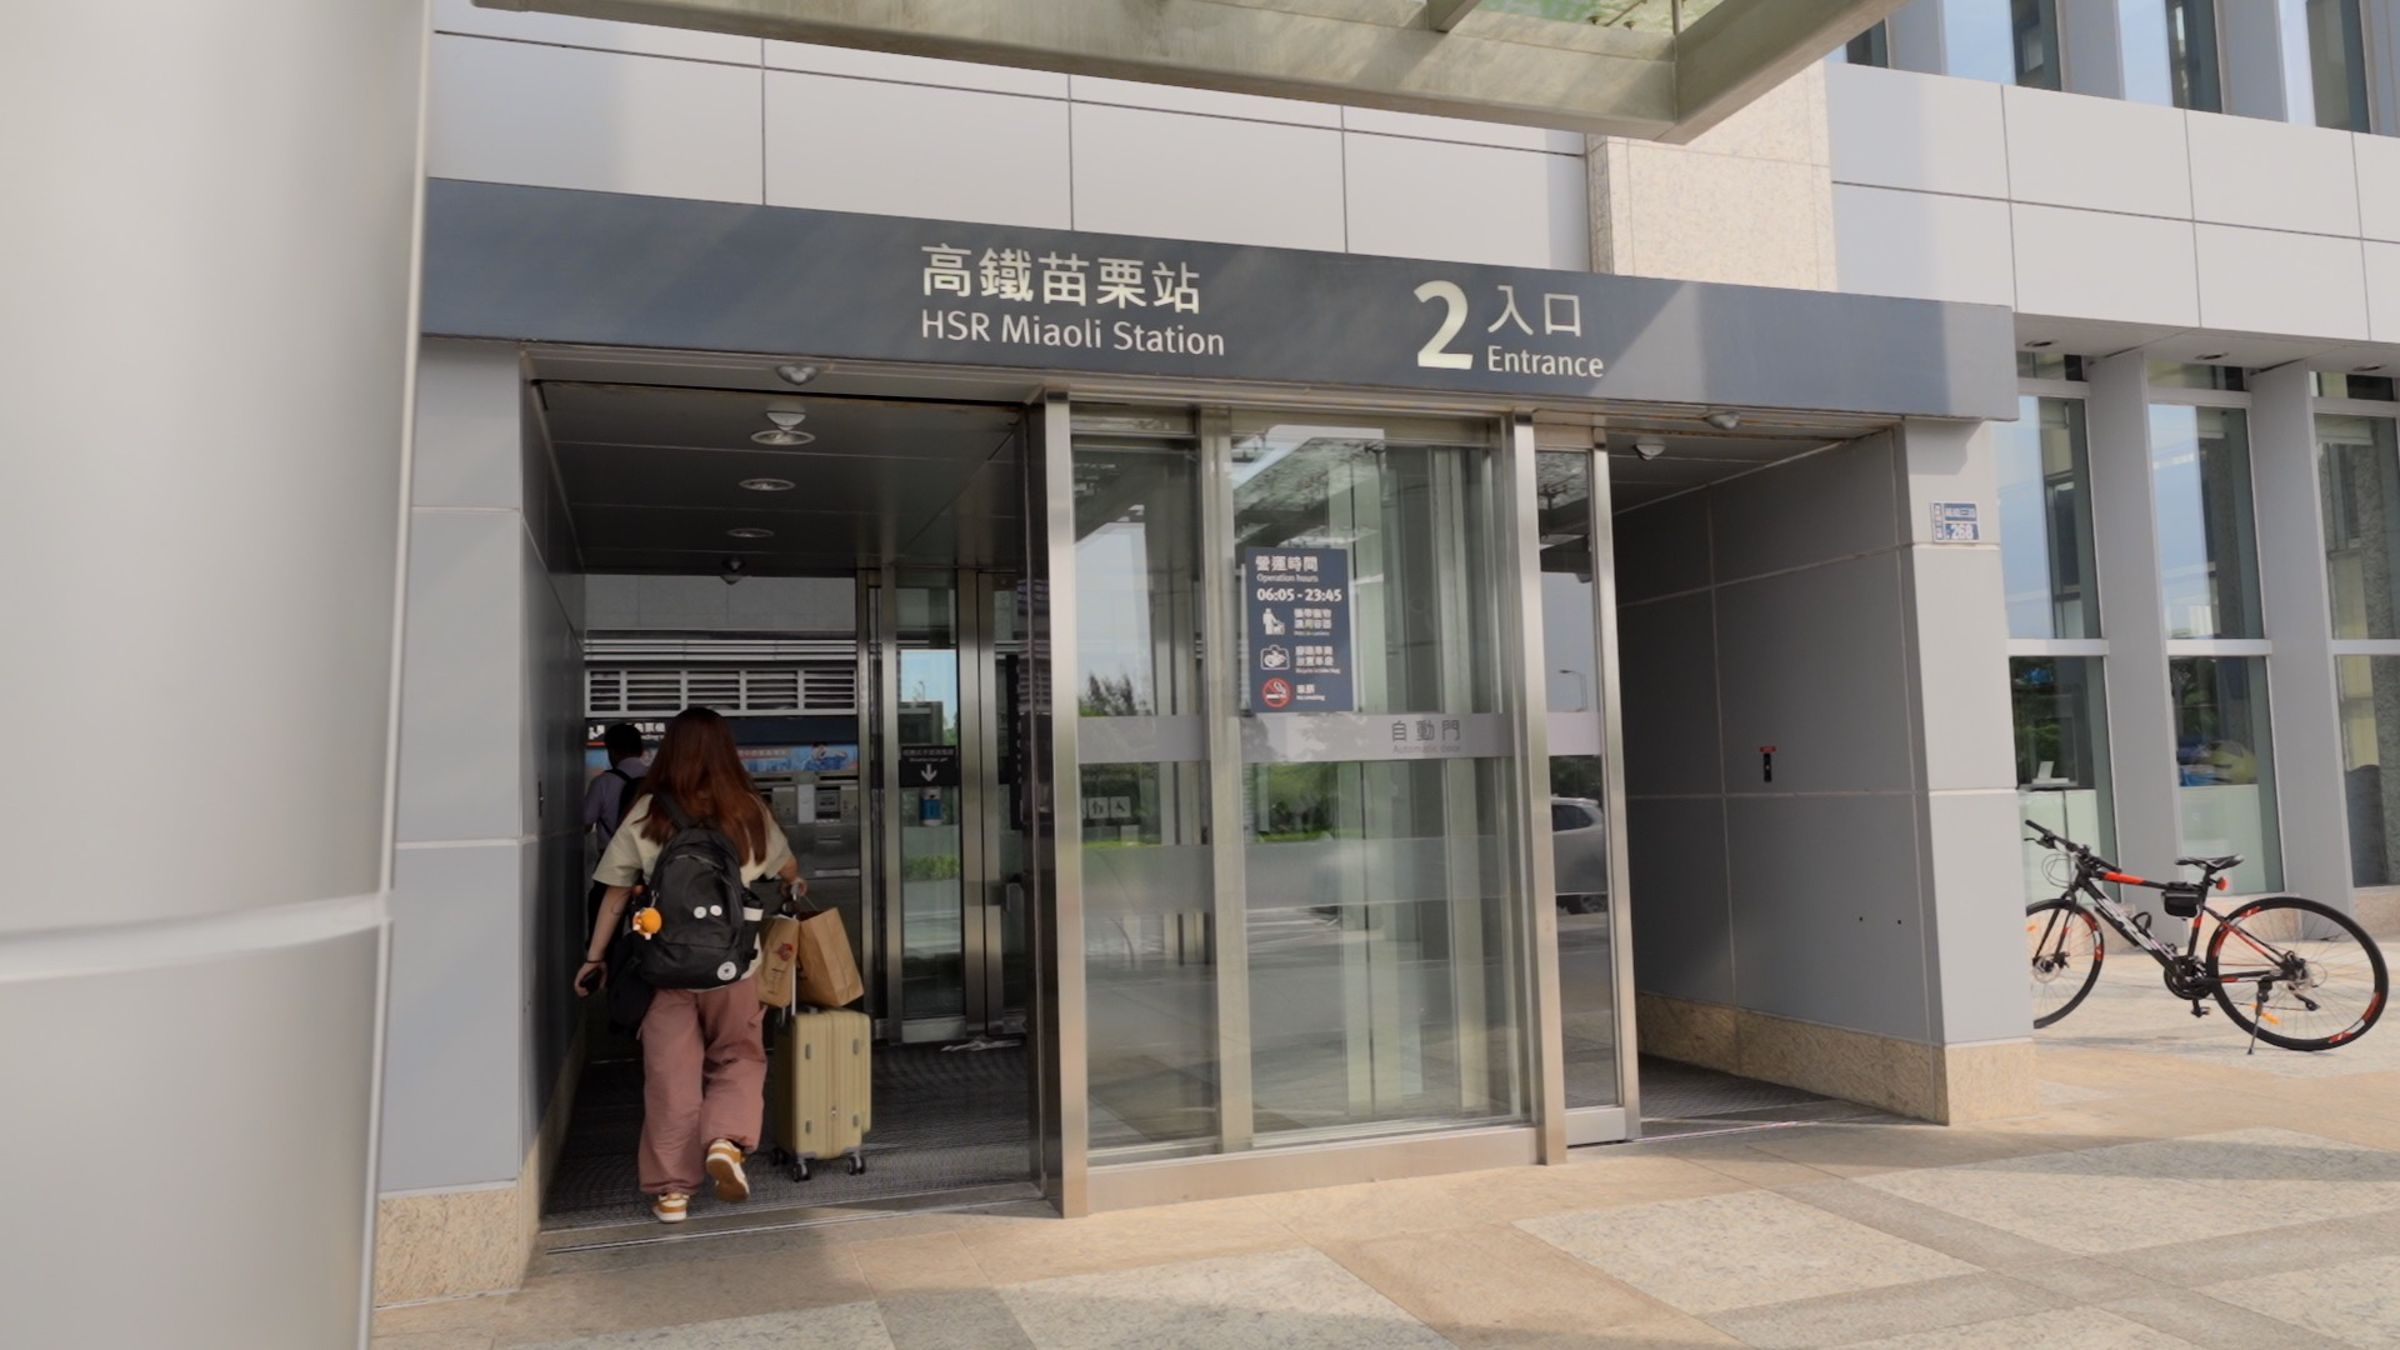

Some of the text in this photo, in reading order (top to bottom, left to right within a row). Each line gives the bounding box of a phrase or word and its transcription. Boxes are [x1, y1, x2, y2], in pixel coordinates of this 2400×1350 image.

[921, 243, 1200, 314] 高鐵苗栗站
[1413, 280, 1473, 370] 2
[1487, 285, 1582, 337] 入口
[922, 309, 1225, 356] HSR Miaoli Station
[1487, 345, 1604, 378] Entrance
[1255, 555, 1318, 572] 營運時間
[1256, 573, 1296, 583] Operation
[1256, 587, 1295, 601] 06:05
[1304, 588, 1342, 602] 23:45
[1392, 719, 1461, 741] 自動門
